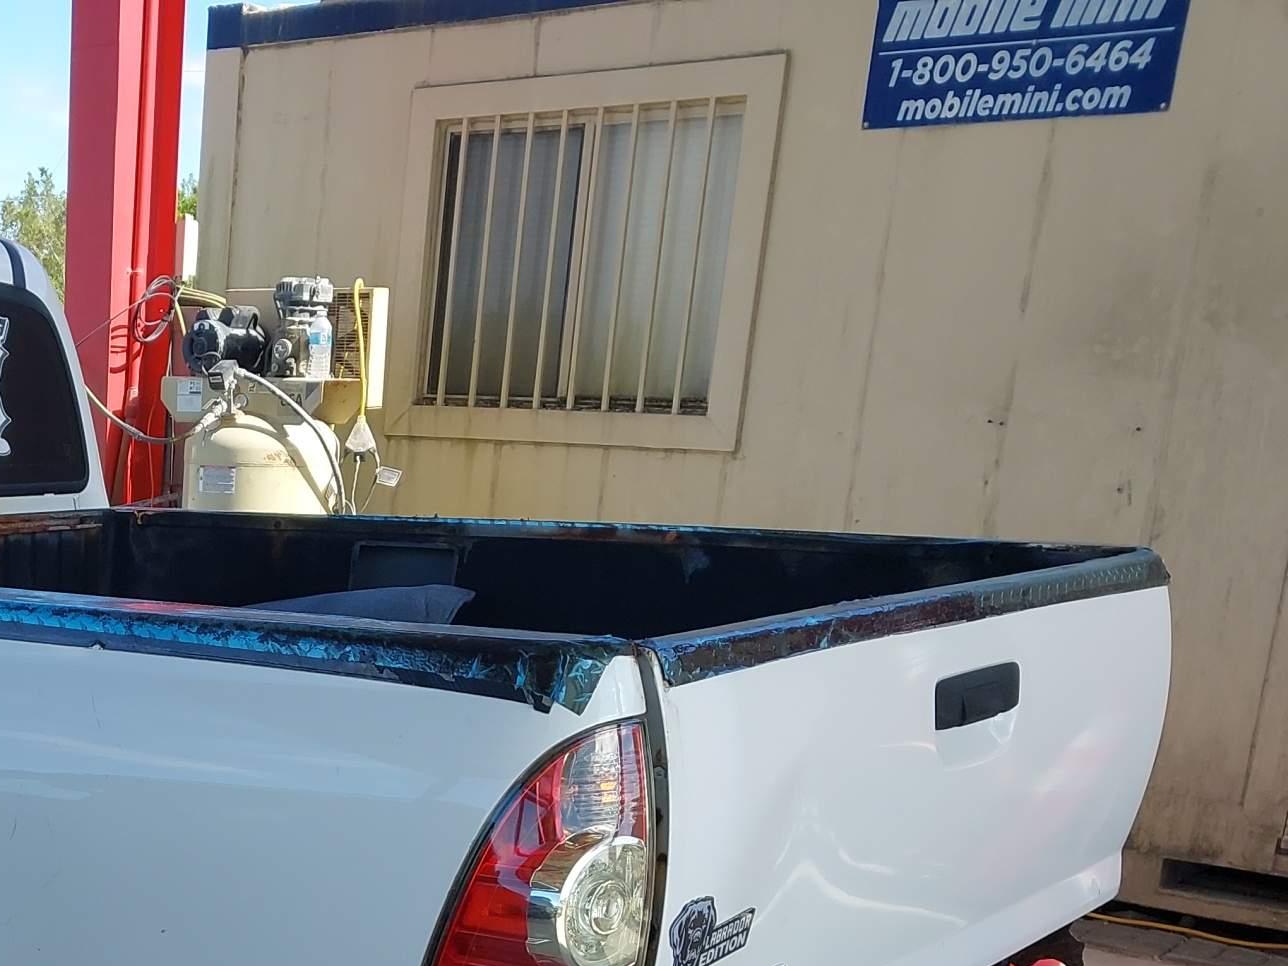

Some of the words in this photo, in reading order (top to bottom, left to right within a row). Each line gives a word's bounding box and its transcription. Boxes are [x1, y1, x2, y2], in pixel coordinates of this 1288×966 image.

[882, 0, 1048, 43] mobile
[888, 37, 1156, 88] 1-800-950-6464
[896, 83, 1132, 122] mobilemini.com
[705, 914, 751, 948] LABRADOR
